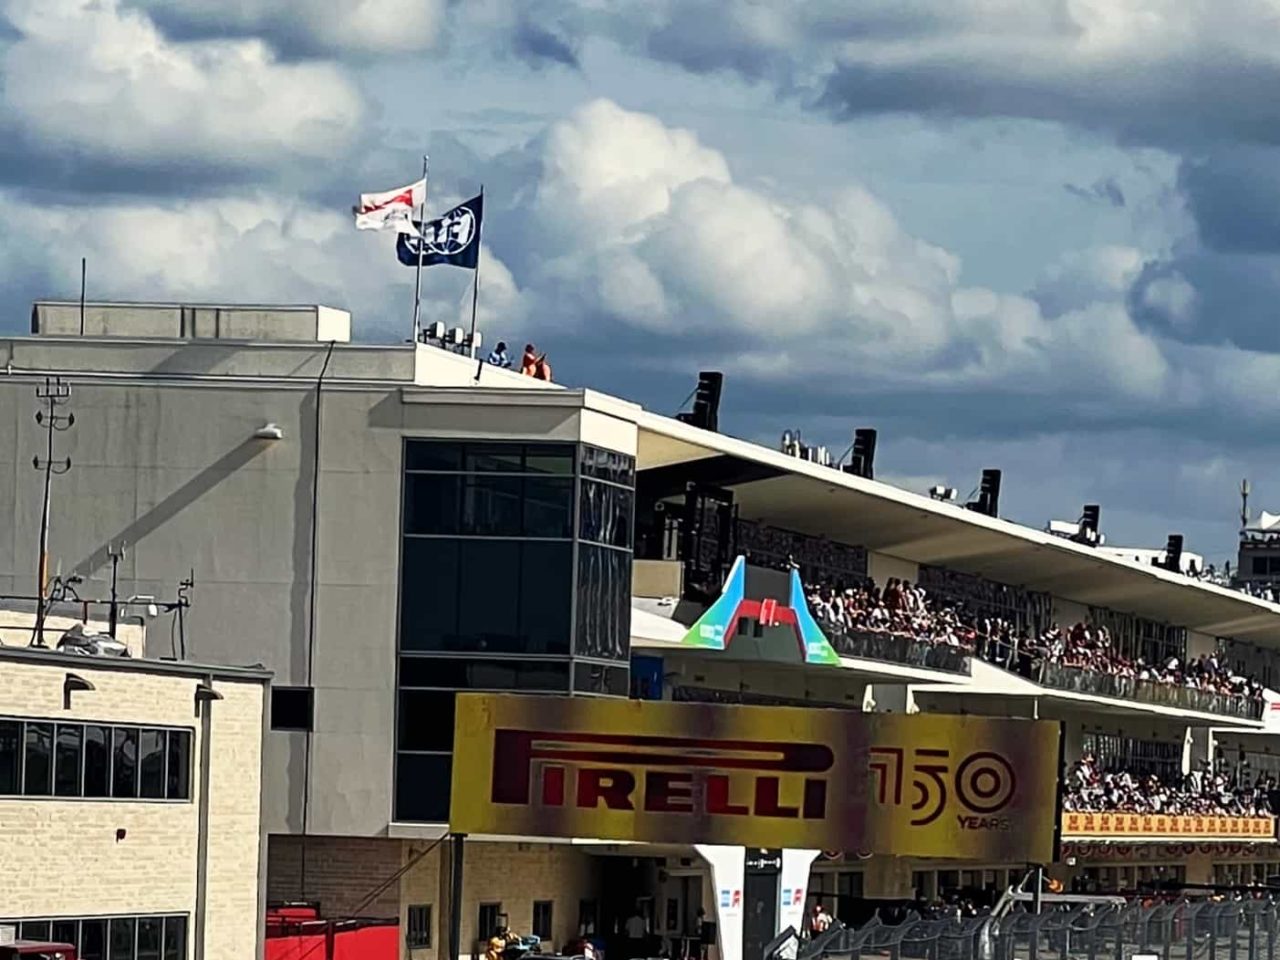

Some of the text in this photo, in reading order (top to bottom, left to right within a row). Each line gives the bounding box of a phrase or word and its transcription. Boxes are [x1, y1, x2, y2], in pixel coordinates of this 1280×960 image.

[491, 729, 834, 819] PIRELLI
[870, 748, 1016, 827] 150
[957, 816, 1010, 832] YEARS
